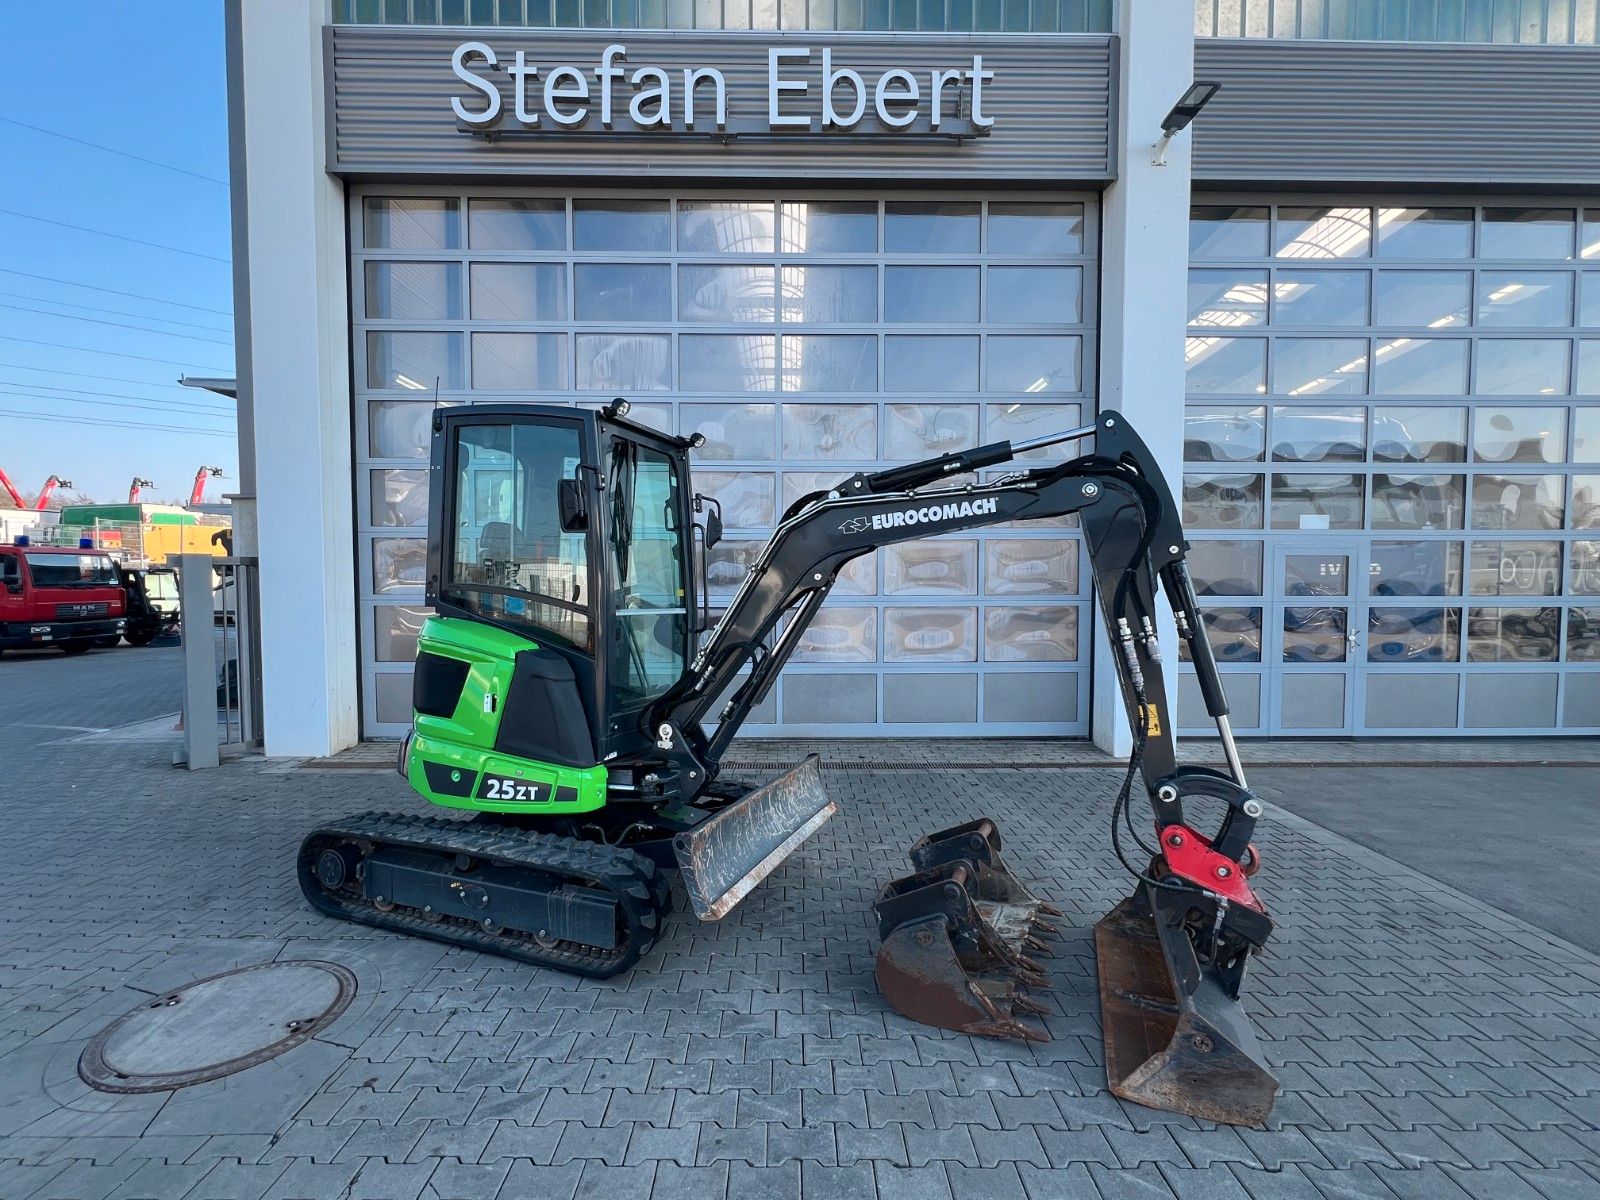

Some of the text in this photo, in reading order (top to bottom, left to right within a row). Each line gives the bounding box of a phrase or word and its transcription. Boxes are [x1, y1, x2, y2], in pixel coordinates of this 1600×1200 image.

[450, 41, 995, 128] Stefan Ebert
[871, 497, 997, 530] EUROCOMACH
